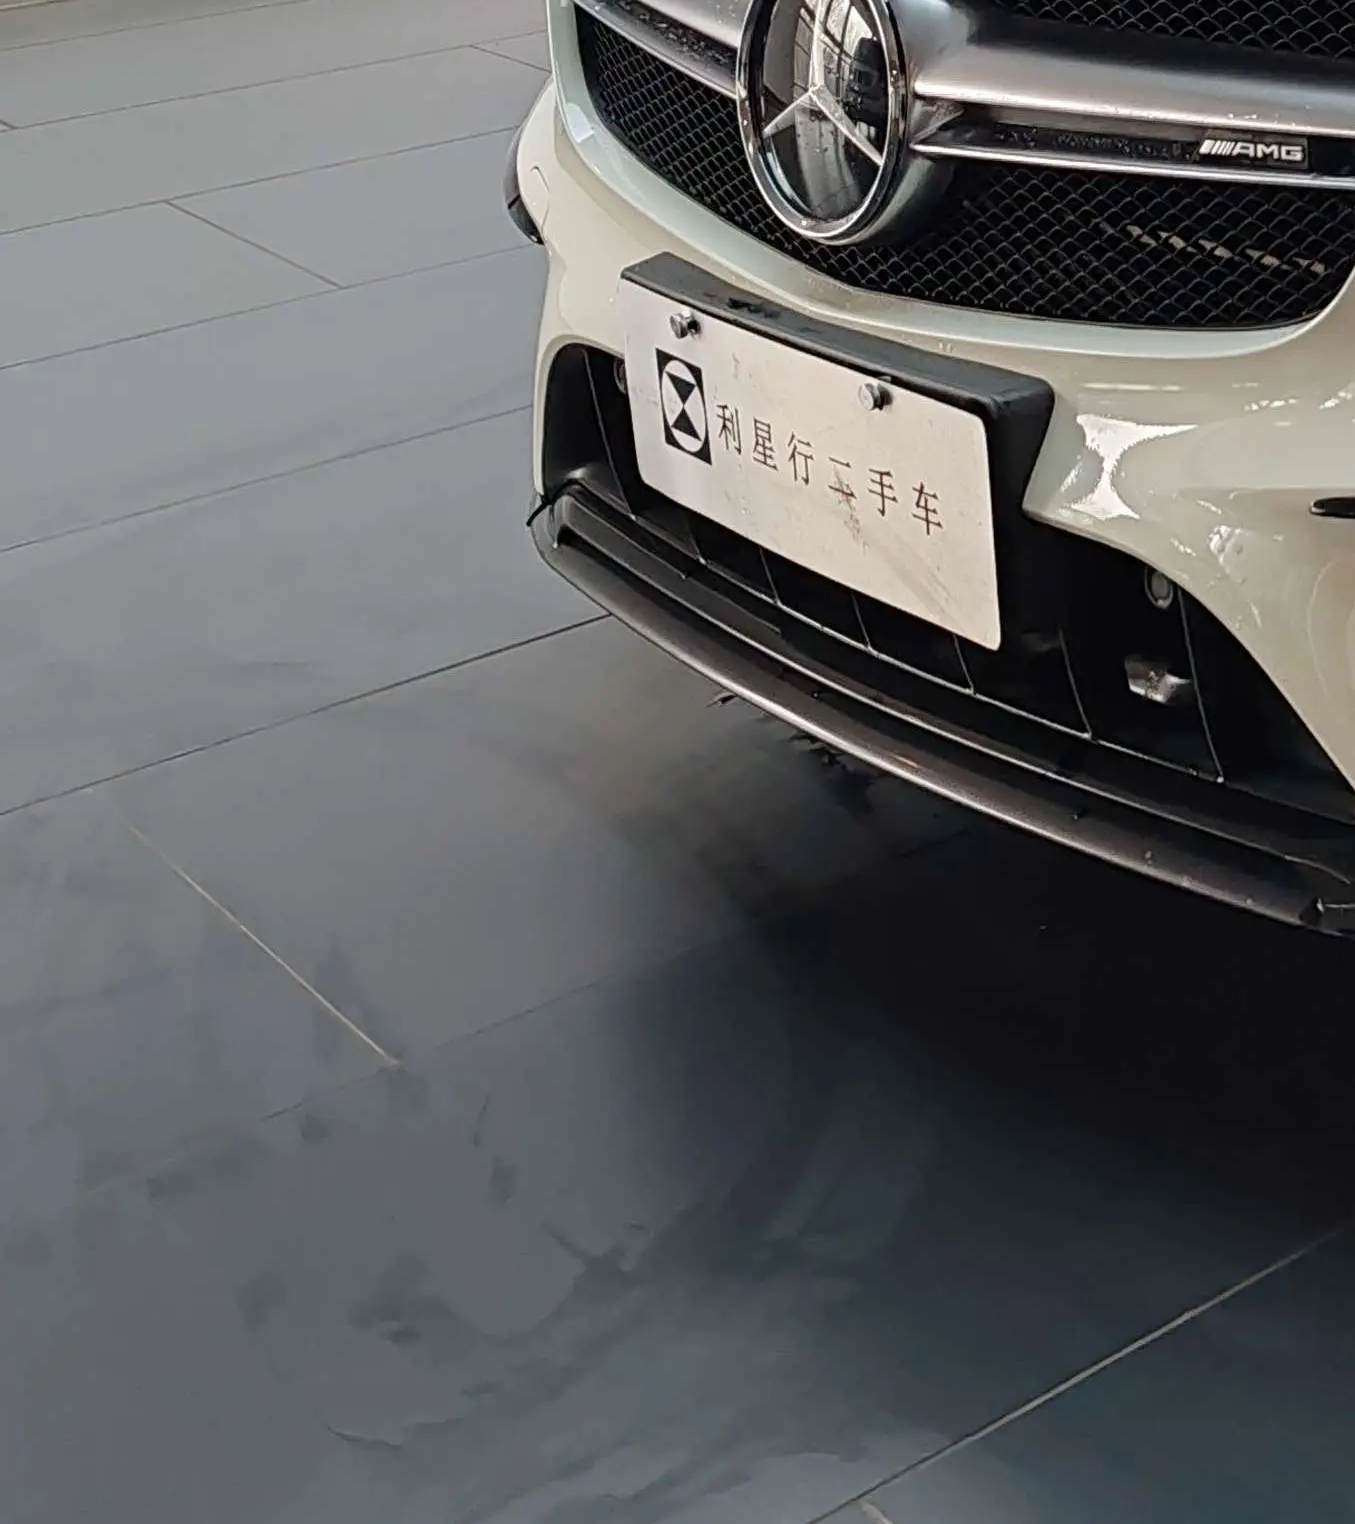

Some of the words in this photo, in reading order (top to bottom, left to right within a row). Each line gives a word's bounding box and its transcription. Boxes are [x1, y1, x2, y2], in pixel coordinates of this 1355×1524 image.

[716, 403, 944, 536] 利星行二手车
